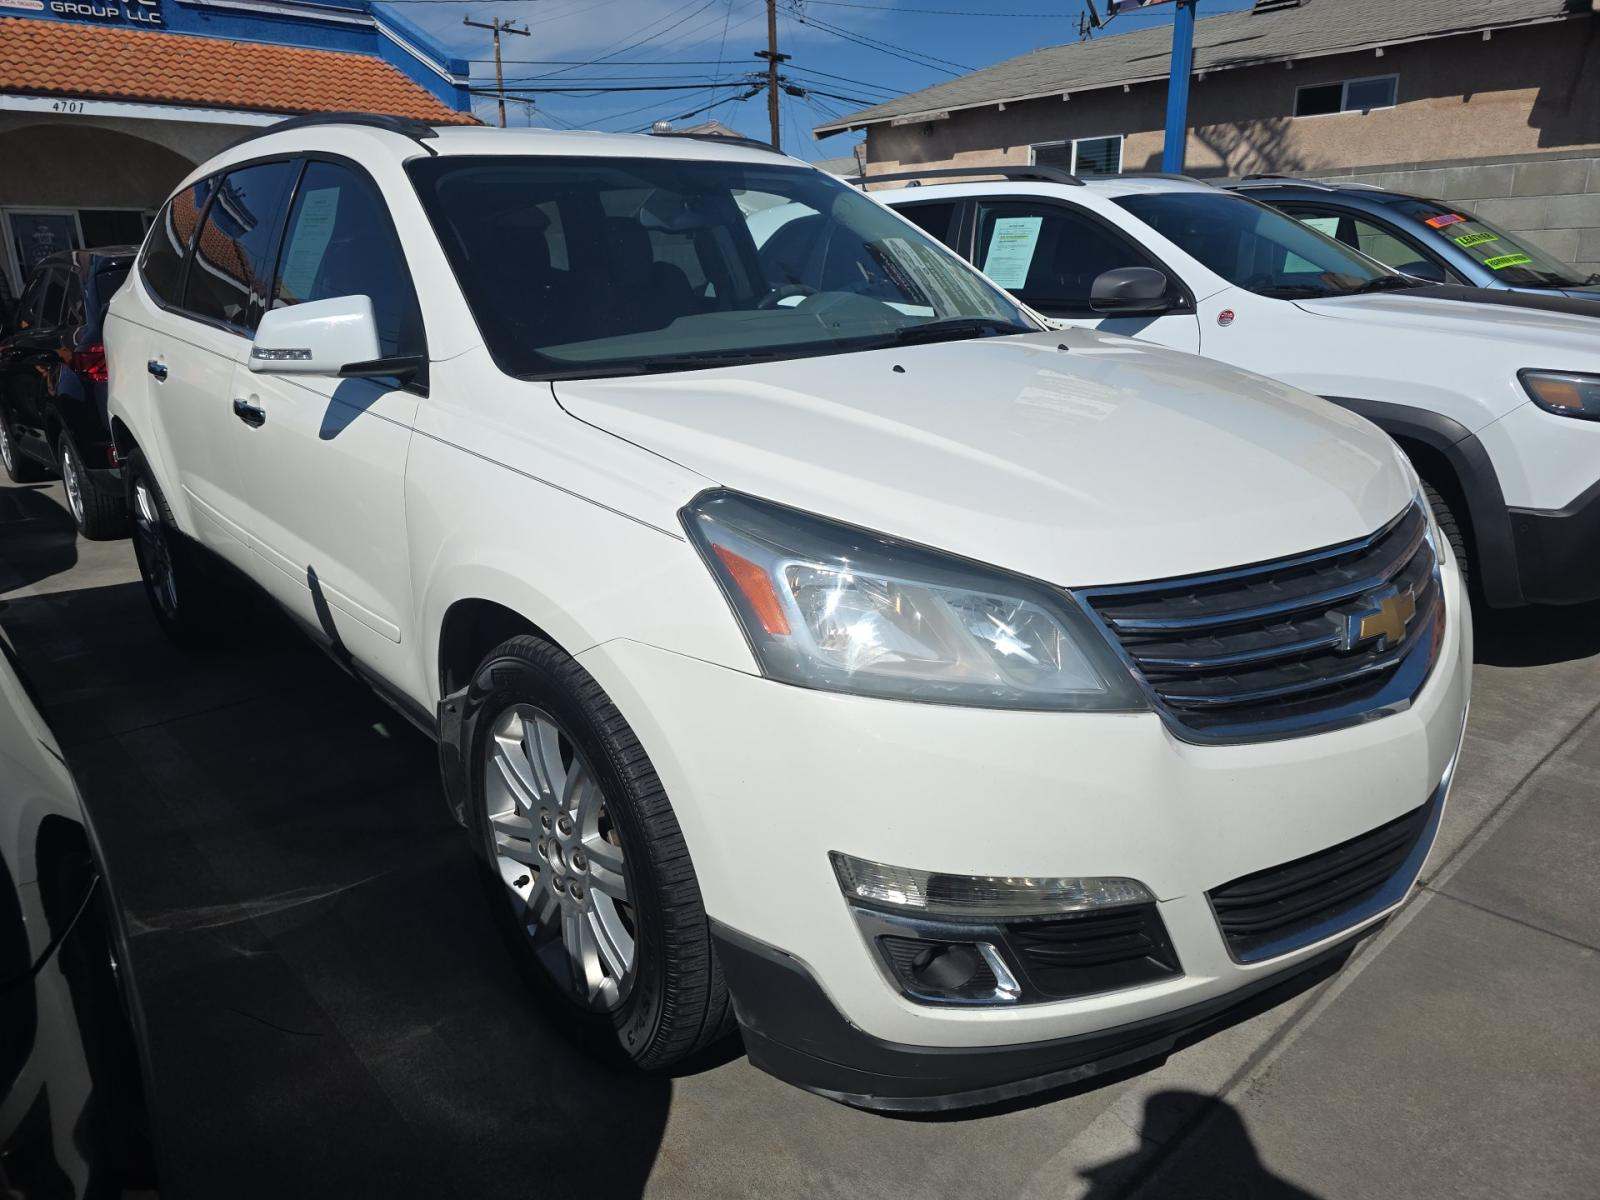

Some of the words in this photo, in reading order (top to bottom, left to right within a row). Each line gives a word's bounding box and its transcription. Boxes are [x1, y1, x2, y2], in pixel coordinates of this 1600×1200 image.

[51, 2, 119, 17] GROUP
[127, 10, 161, 23] LLC
[53, 101, 84, 113] 4701
